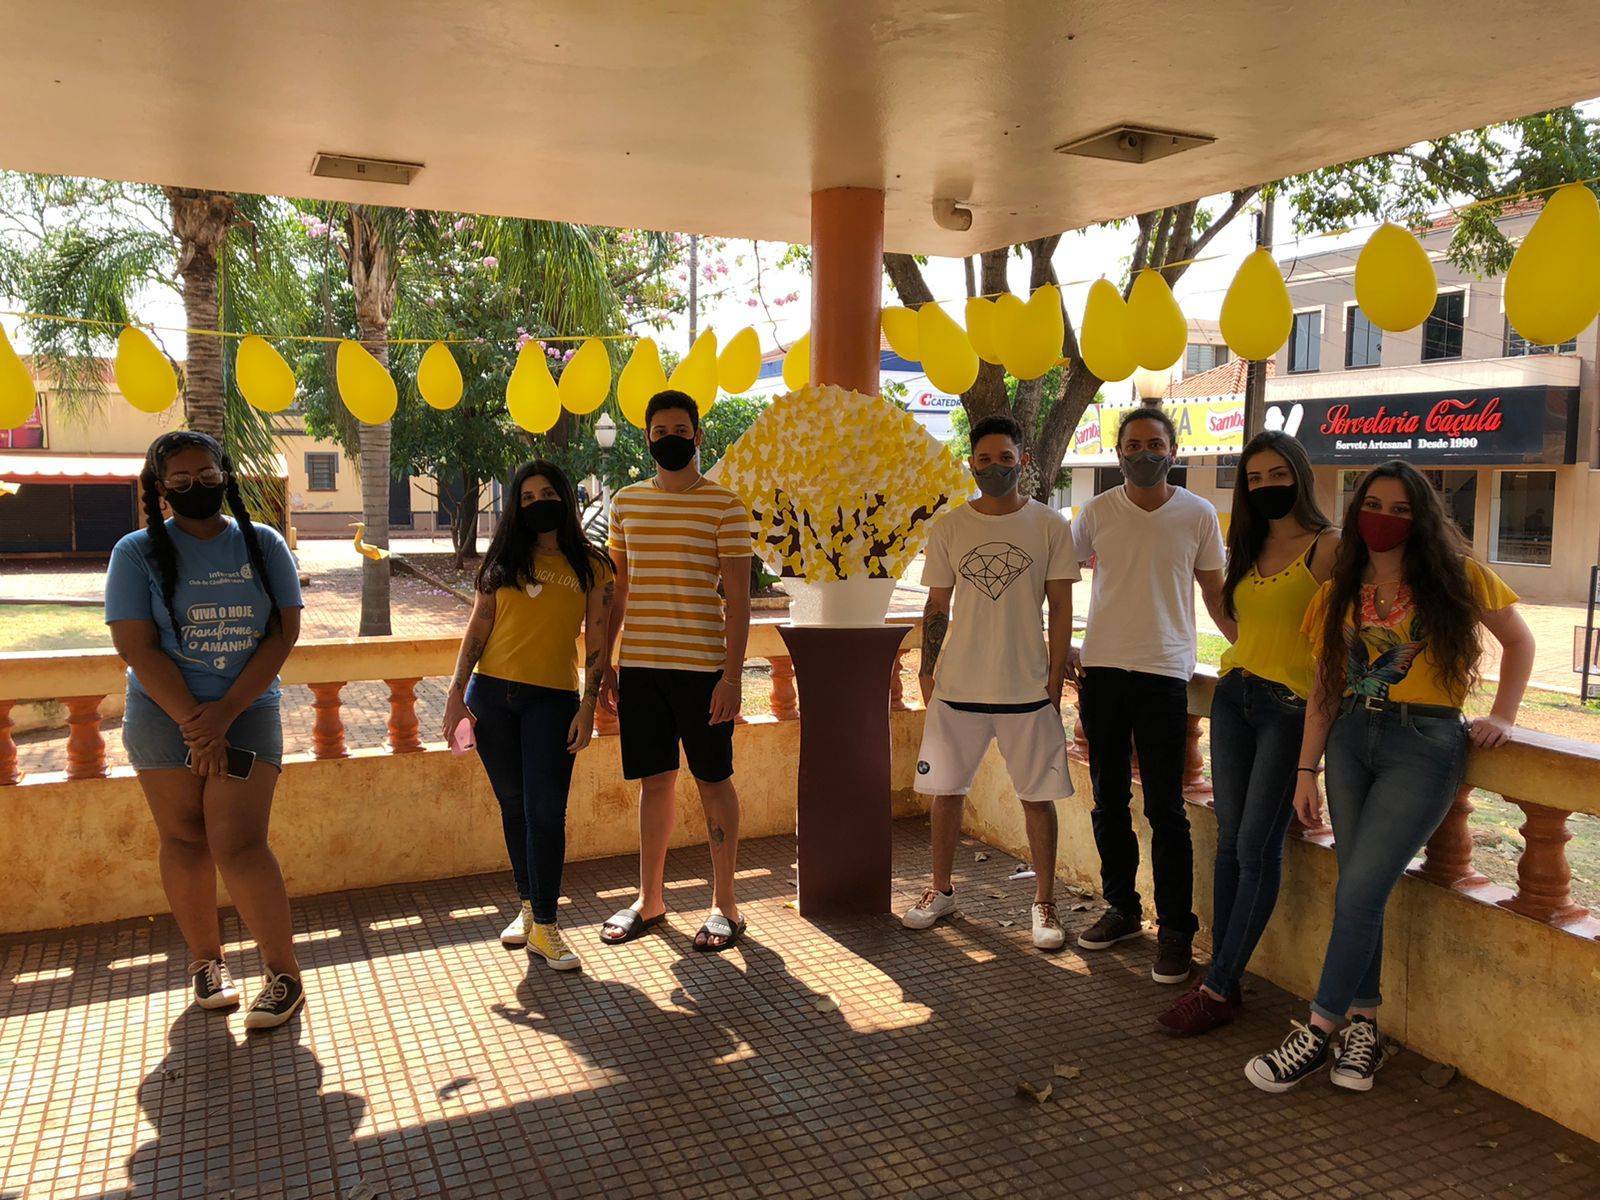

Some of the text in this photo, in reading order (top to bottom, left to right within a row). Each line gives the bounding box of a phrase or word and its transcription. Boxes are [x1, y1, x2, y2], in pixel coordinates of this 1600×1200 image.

[931, 398, 960, 406] CATEDR
[1320, 397, 1502, 436] Sorveteria Caçula
[1335, 437, 1478, 449] Sorvete Artesanal Desde 1990
[192, 607, 217, 620] VIVA
[219, 606, 227, 618] O
[181, 621, 253, 640] Transforme
